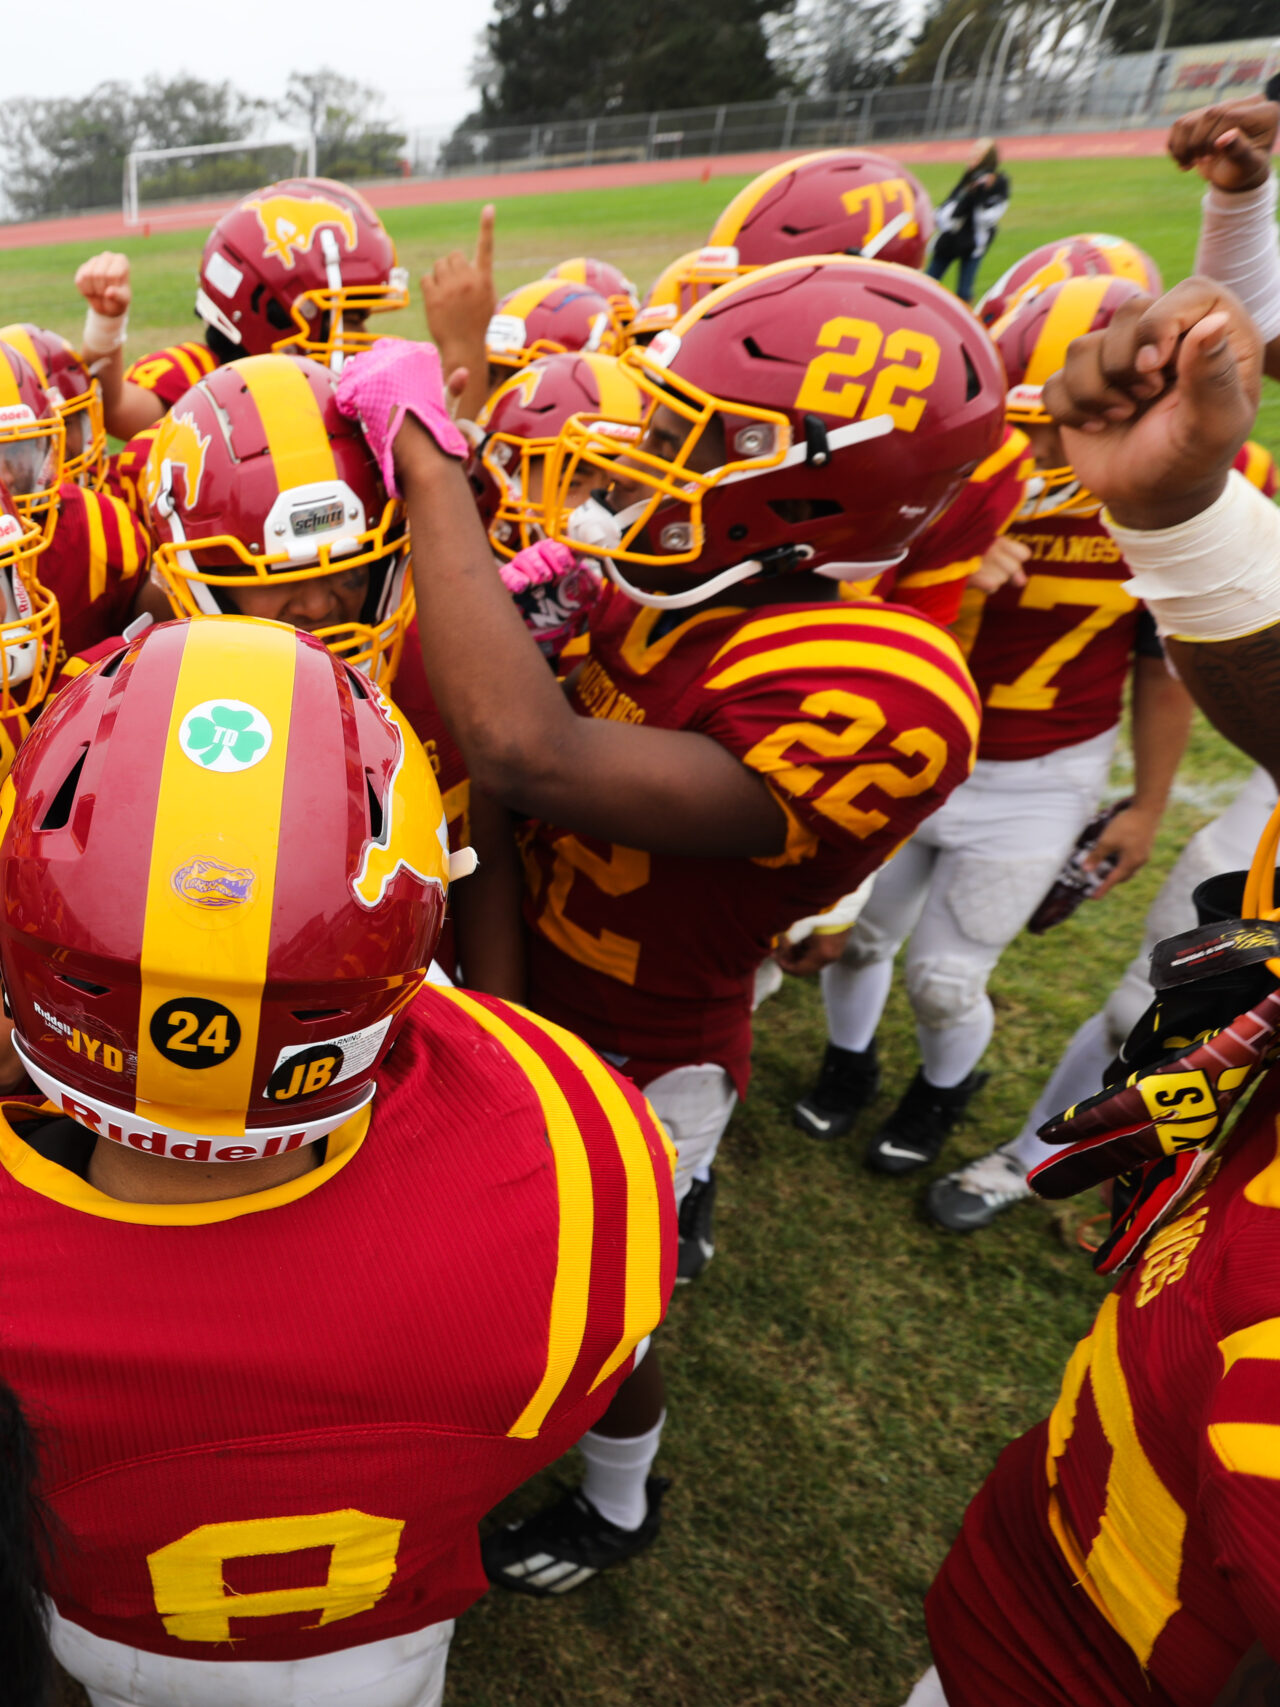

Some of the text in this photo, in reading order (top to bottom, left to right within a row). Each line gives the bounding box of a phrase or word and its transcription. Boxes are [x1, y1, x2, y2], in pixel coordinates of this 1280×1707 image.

[794, 316, 941, 432] 22
[295, 508, 343, 530] schutt
[212, 726, 239, 747] TD
[742, 689, 948, 840] 22
[66, 1027, 123, 1073] JYD
[167, 1010, 230, 1055] 24
[275, 1056, 336, 1100] JB
[61, 1093, 307, 1163] Riddell
